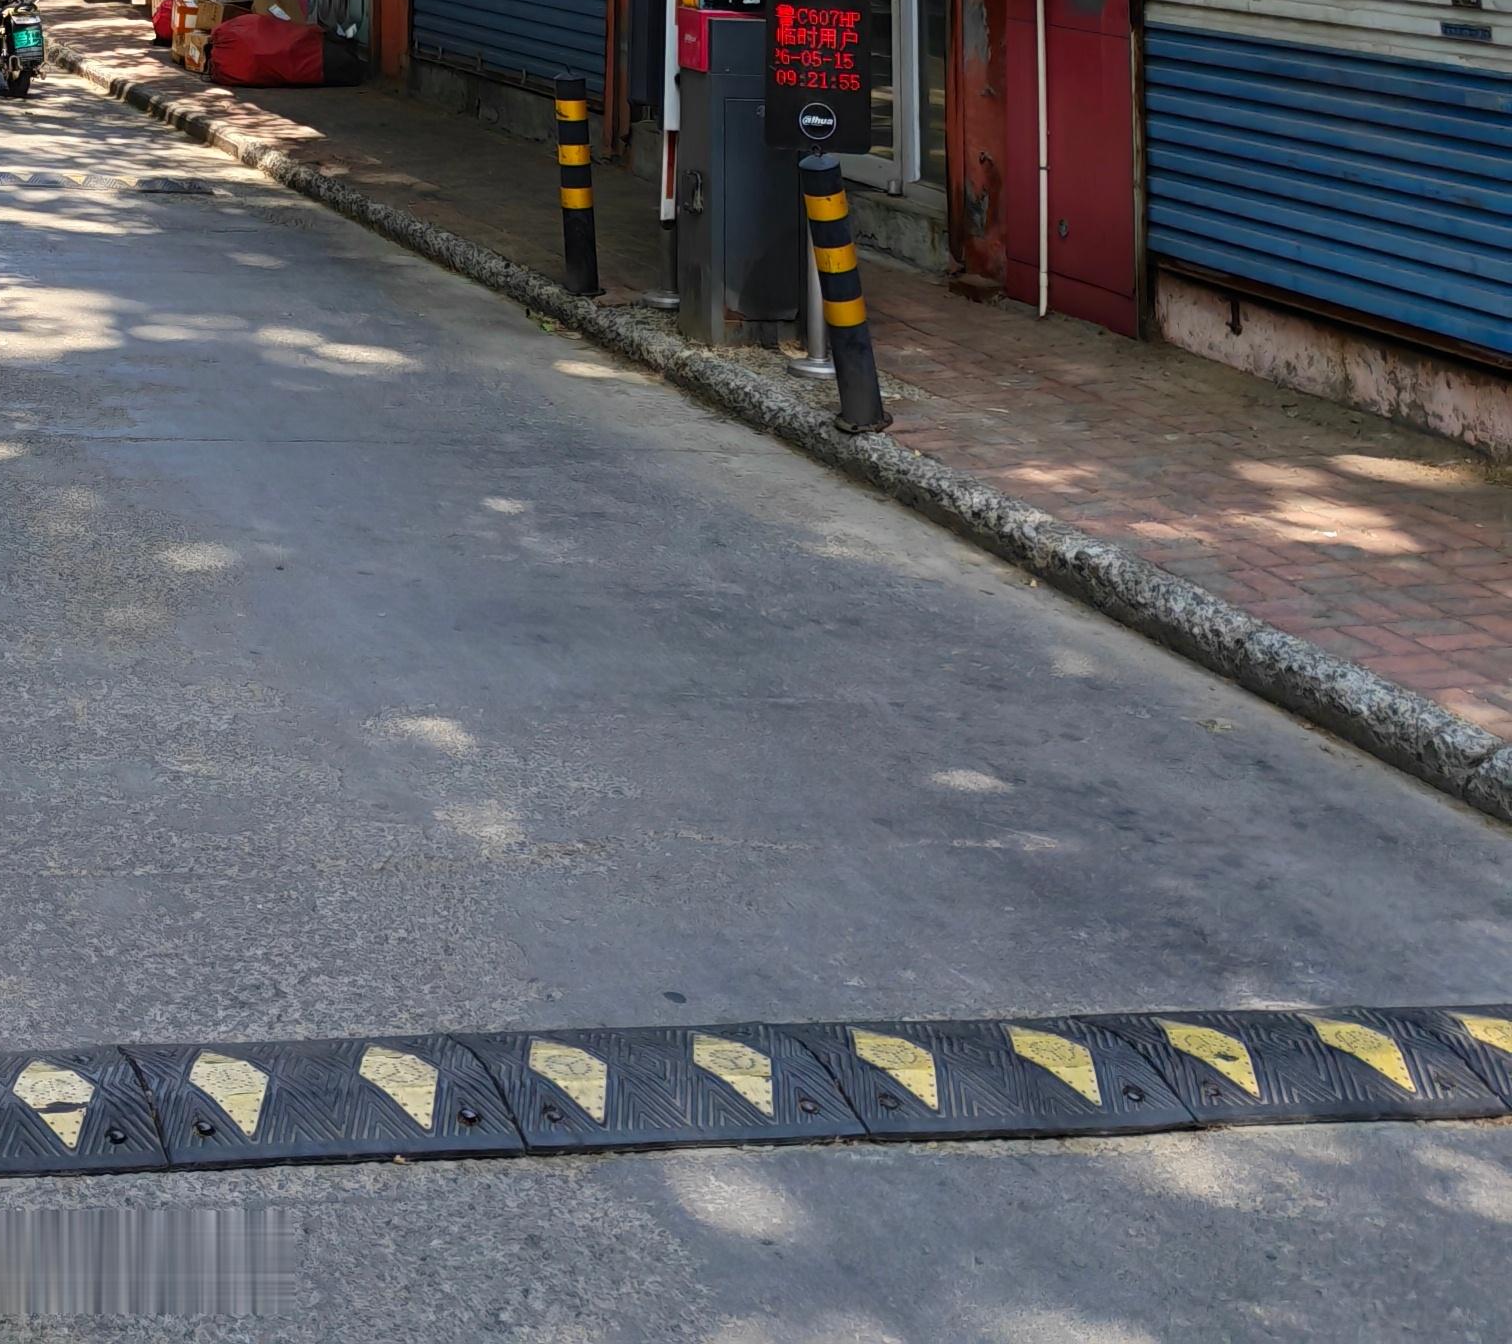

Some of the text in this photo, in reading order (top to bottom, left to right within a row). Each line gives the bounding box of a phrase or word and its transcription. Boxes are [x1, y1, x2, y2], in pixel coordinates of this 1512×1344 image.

[776, 24, 858, 51] 临时用户
[776, 69, 861, 91] 09:21:55
